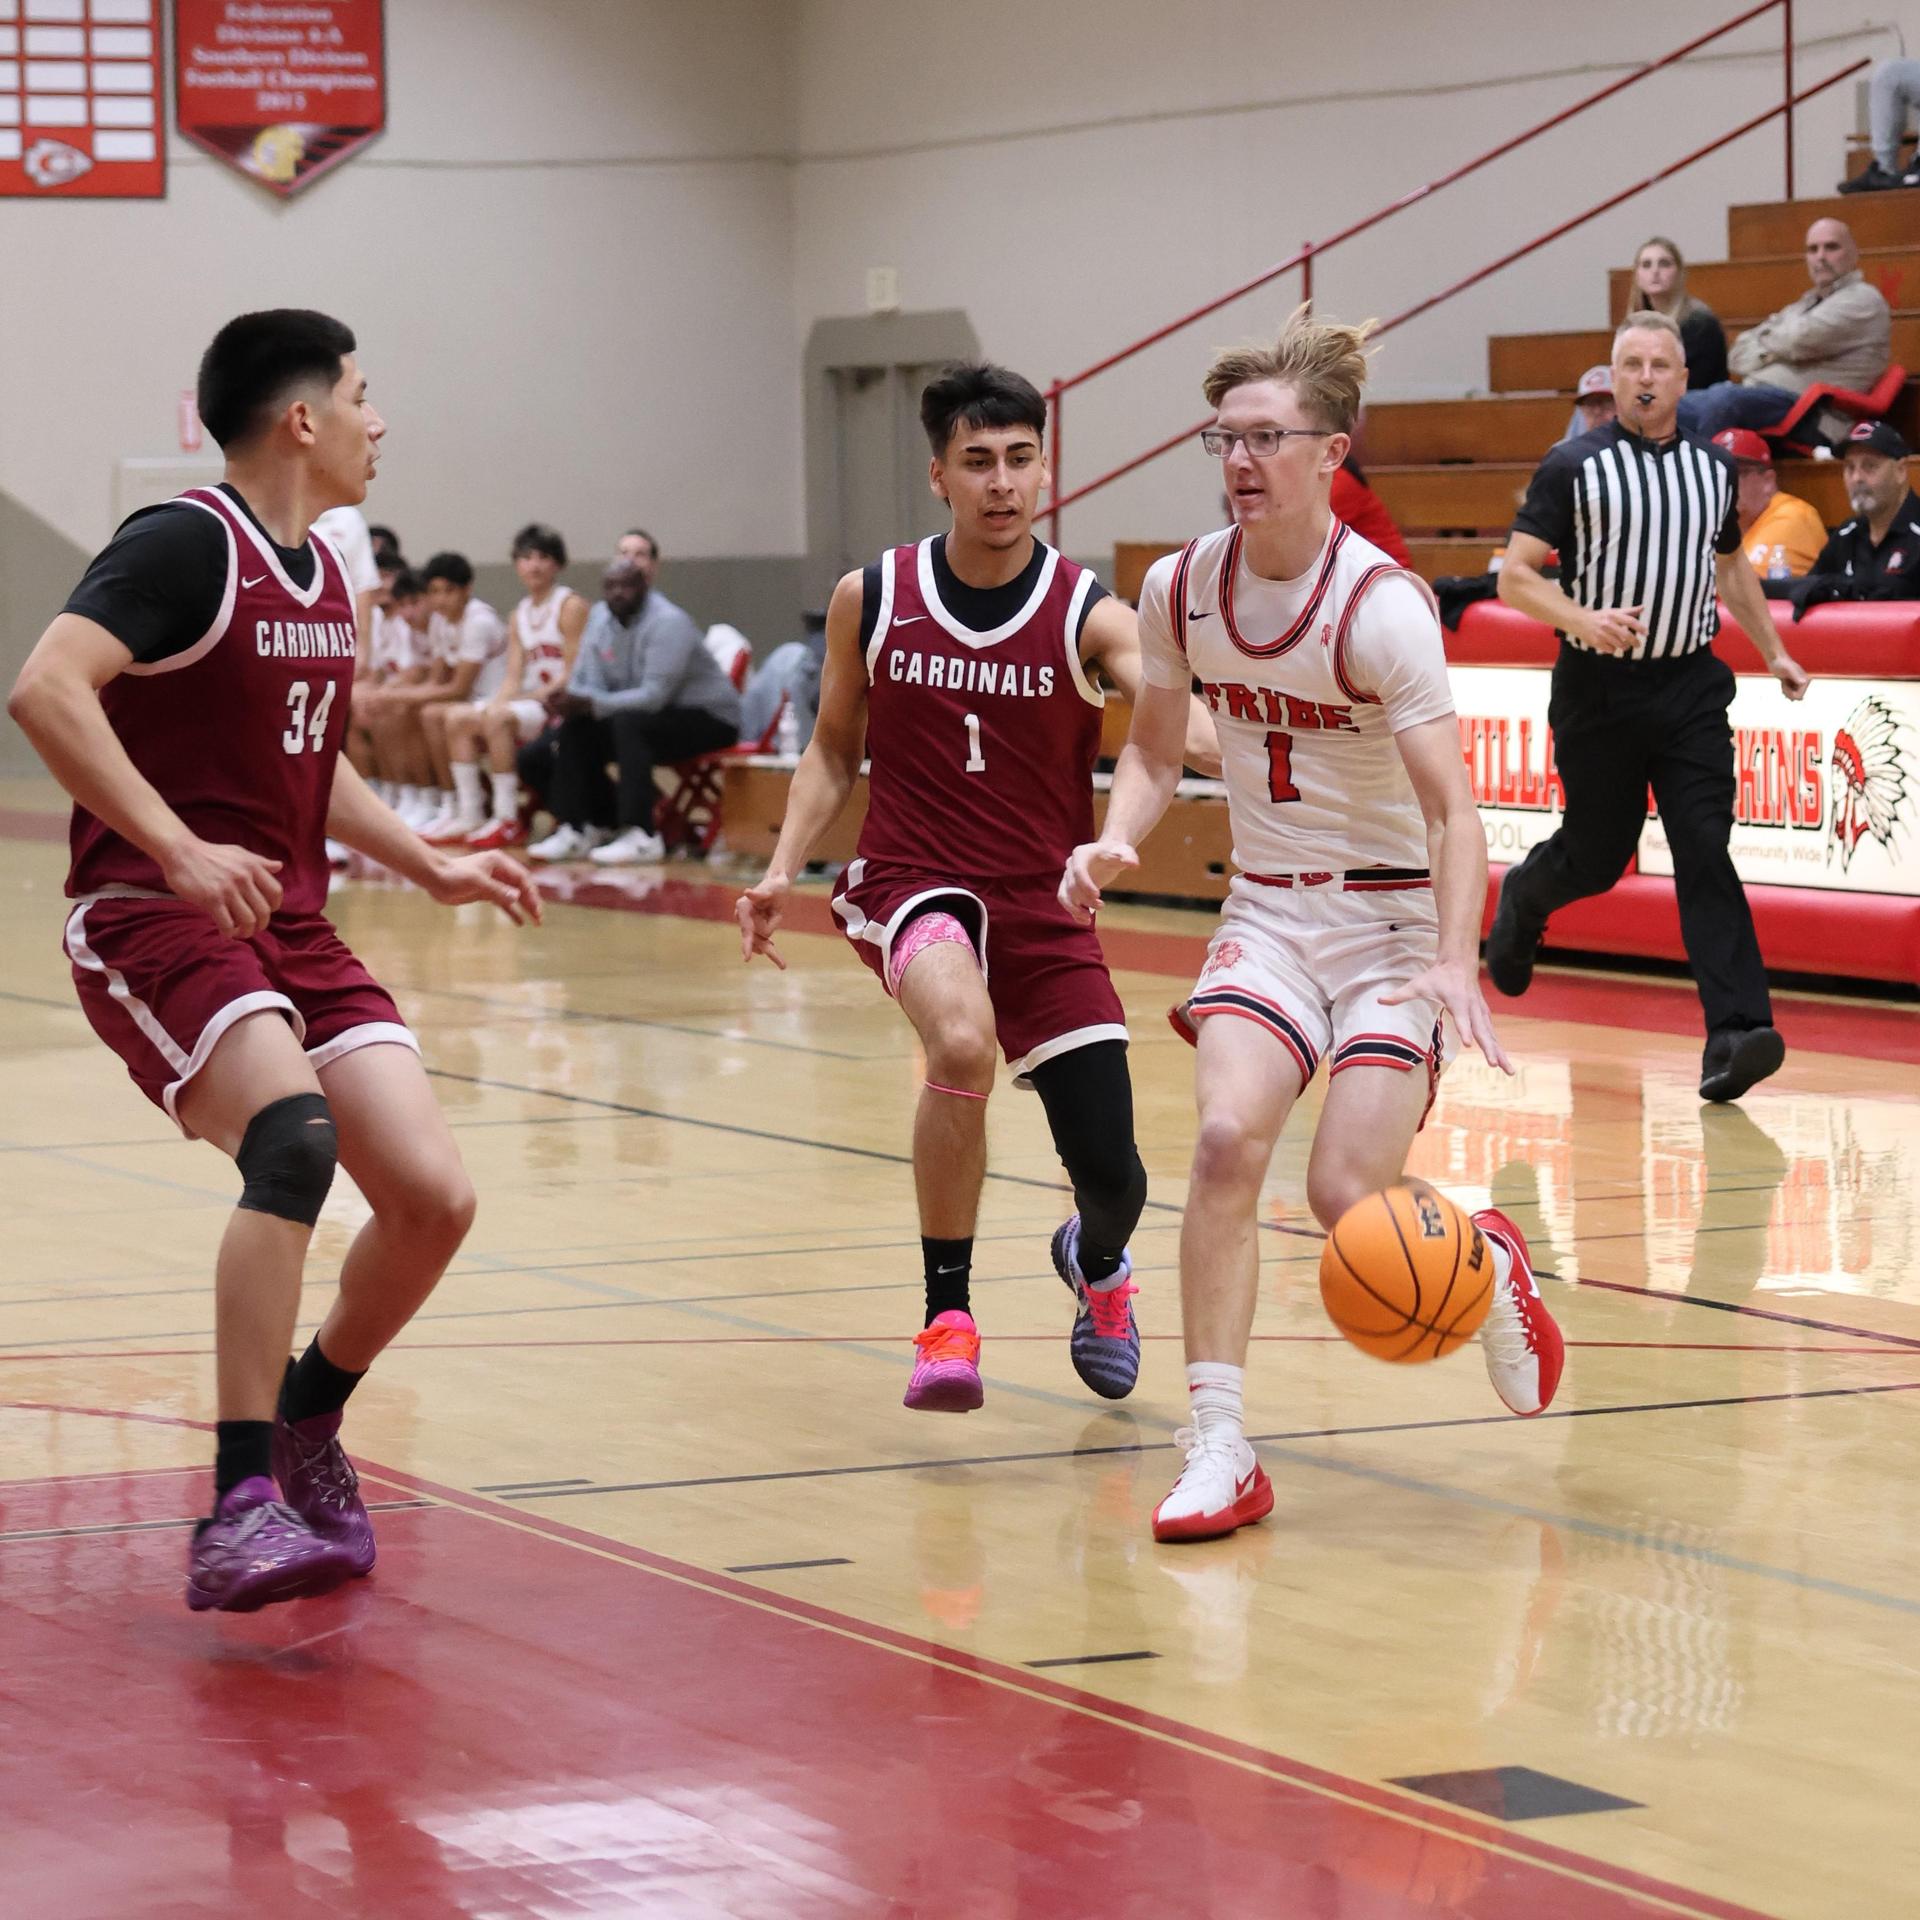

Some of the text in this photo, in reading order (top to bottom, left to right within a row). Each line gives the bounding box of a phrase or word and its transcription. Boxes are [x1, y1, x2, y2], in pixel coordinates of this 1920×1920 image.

[216, 24, 304, 44] Division
[192, 46, 286, 65] Southern
[184, 67, 376, 95] Football Champions
[256, 620, 355, 657] CARDINALS
[889, 649, 1054, 697] CARDINALS
[283, 680, 336, 754] 34
[1201, 683, 1360, 733] TRIBE
[964, 713, 985, 772] 1
[1264, 730, 1301, 803] 1
[1457, 716, 1822, 830] HILLA KINS
[1483, 822, 1531, 850] OOL
[1730, 842, 1788, 868] ommunity
[1793, 846, 1822, 863] Wide
